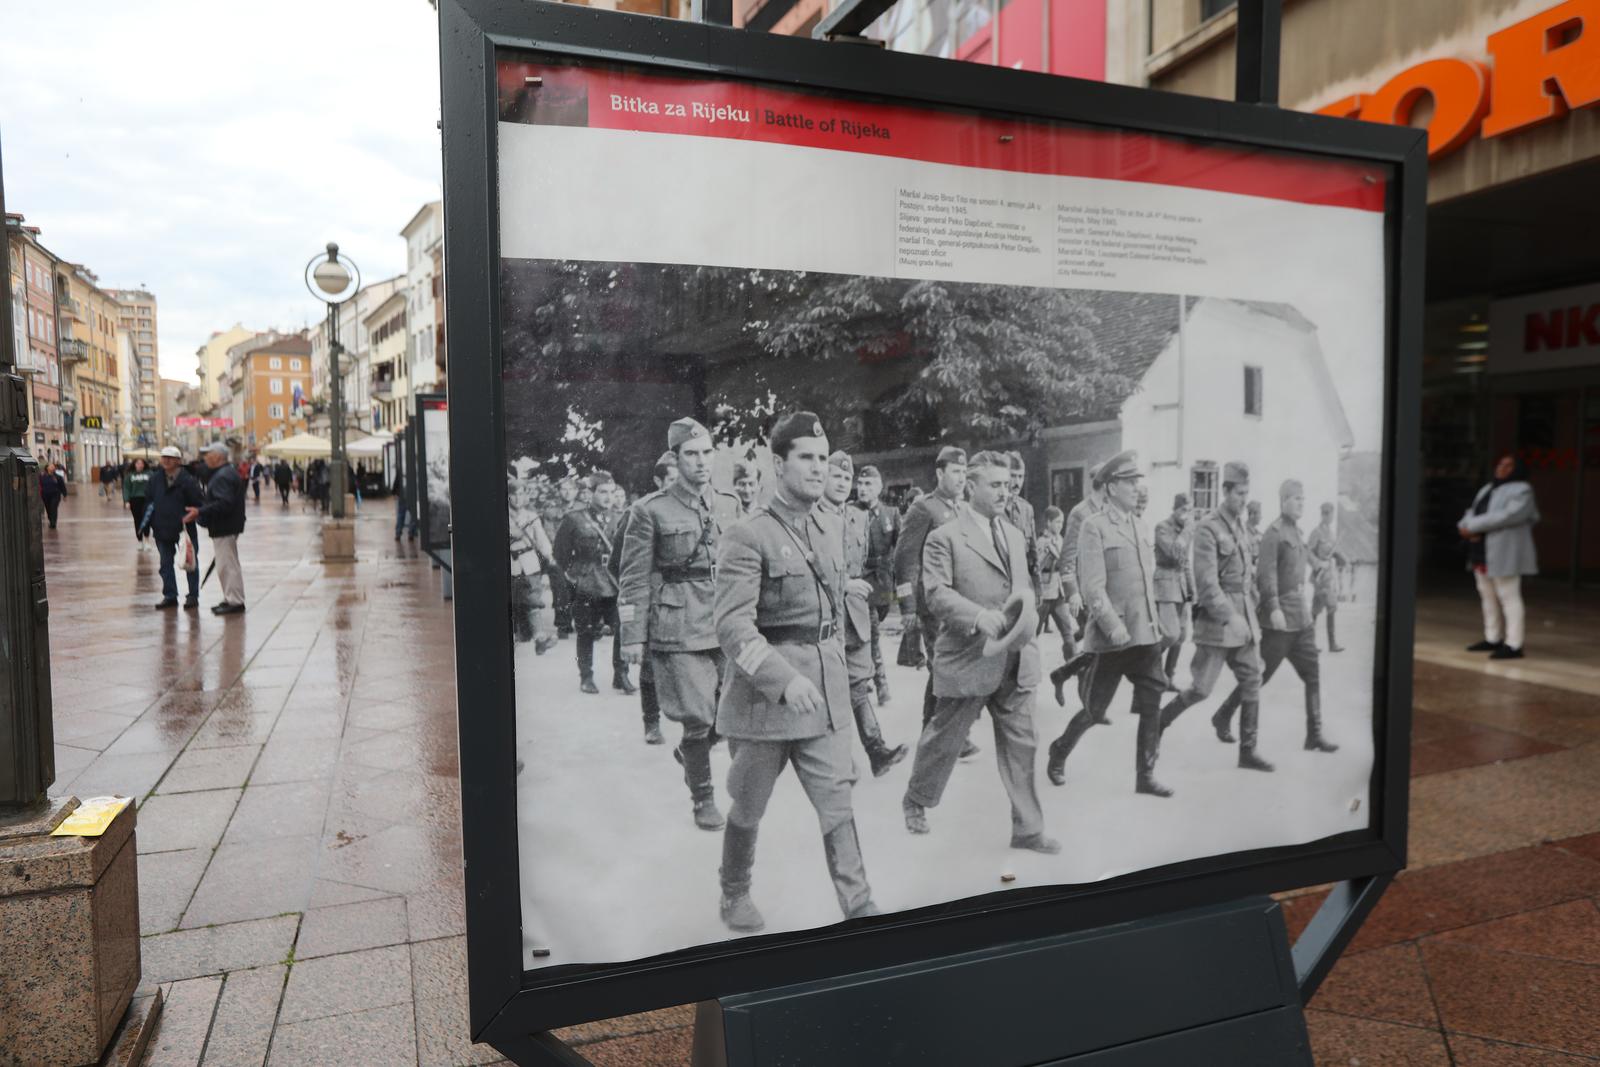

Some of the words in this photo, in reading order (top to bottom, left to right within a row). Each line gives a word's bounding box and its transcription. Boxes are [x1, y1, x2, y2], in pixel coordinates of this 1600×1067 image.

[1310, 0, 1600, 160] OR
[609, 94, 659, 116] Bitka
[664, 102, 687, 117] za
[691, 101, 751, 124] Rijeku
[764, 109, 814, 131] Battle
[818, 118, 837, 133] of
[840, 120, 891, 140] Rijeka
[922, 192, 939, 202] Josip
[941, 193, 954, 202] Broz
[956, 194, 968, 203] Tito
[923, 216, 947, 225] general
[948, 216, 963, 225] Peko
